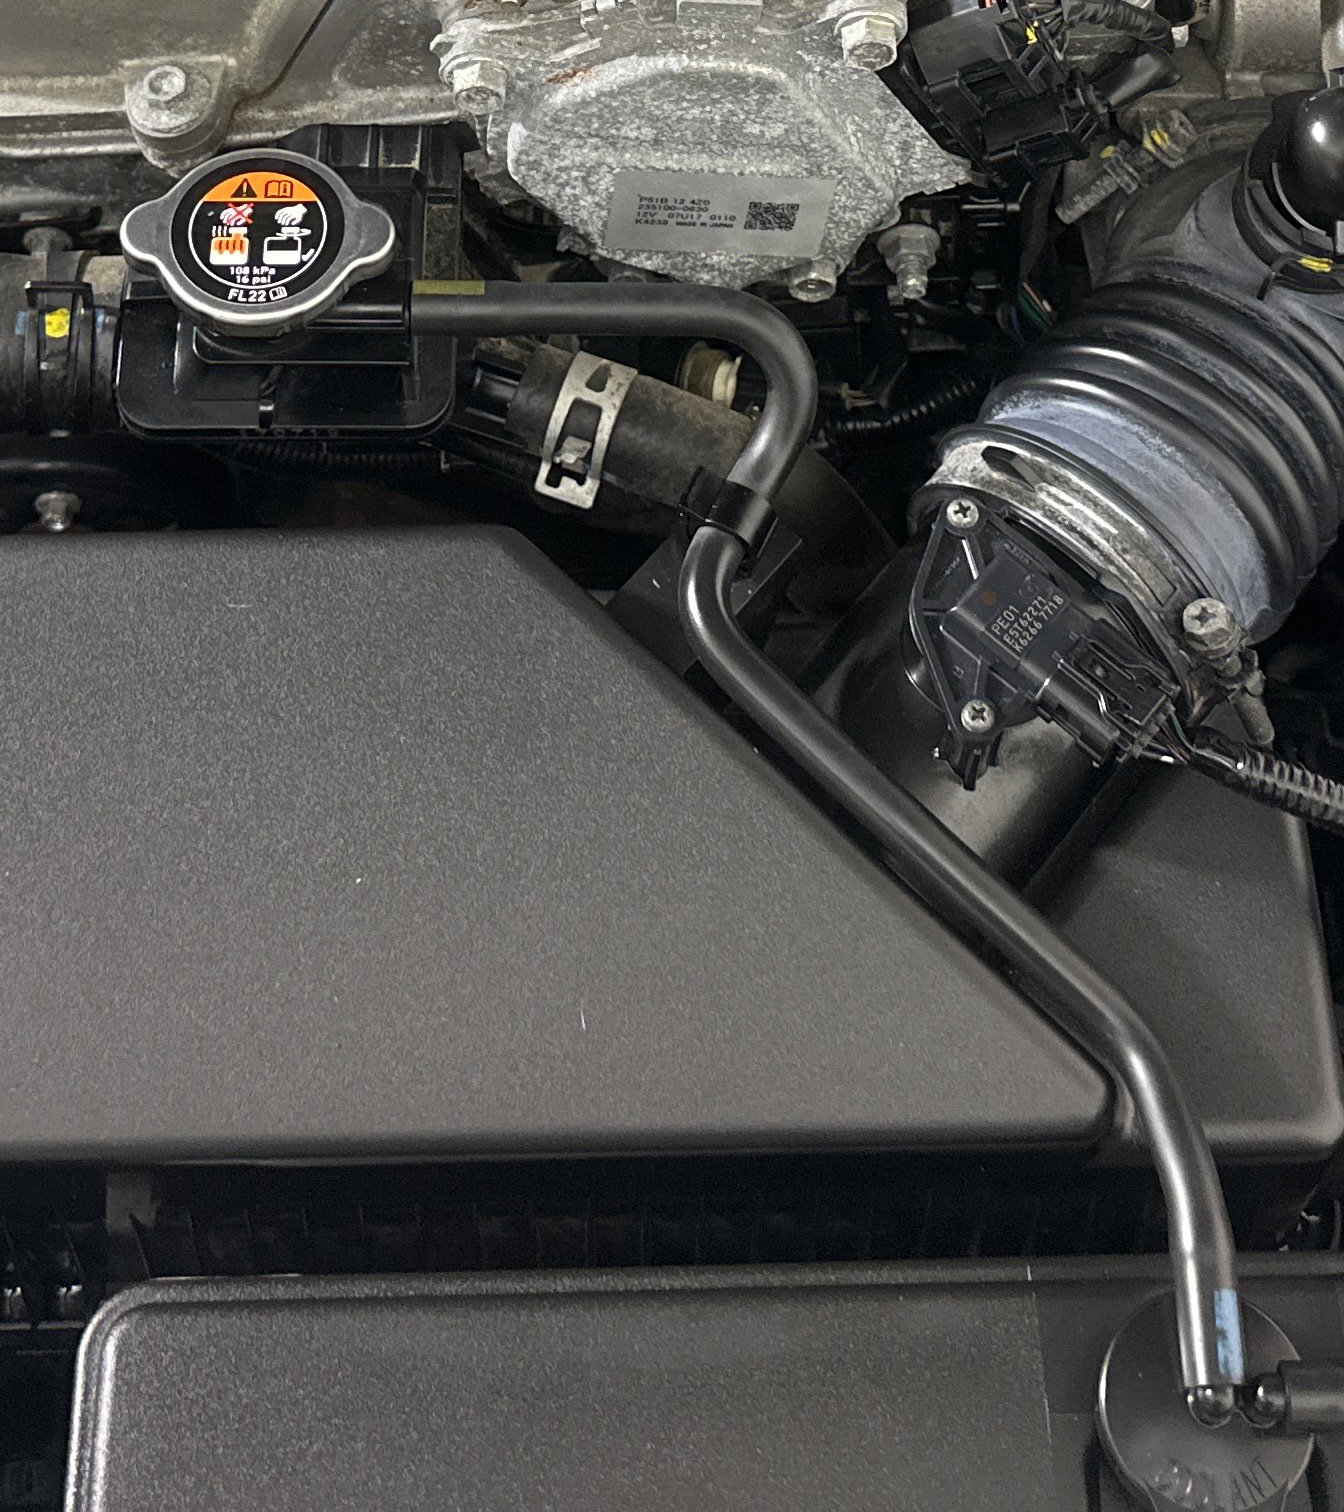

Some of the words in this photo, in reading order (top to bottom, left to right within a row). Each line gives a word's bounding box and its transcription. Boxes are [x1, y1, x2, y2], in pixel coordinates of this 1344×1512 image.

[230, 266, 250, 275] 108
[253, 266, 276, 275] kPa
[236, 275, 249, 283] 16
[252, 275, 271, 285] psi
[228, 288, 266, 302] FL22
